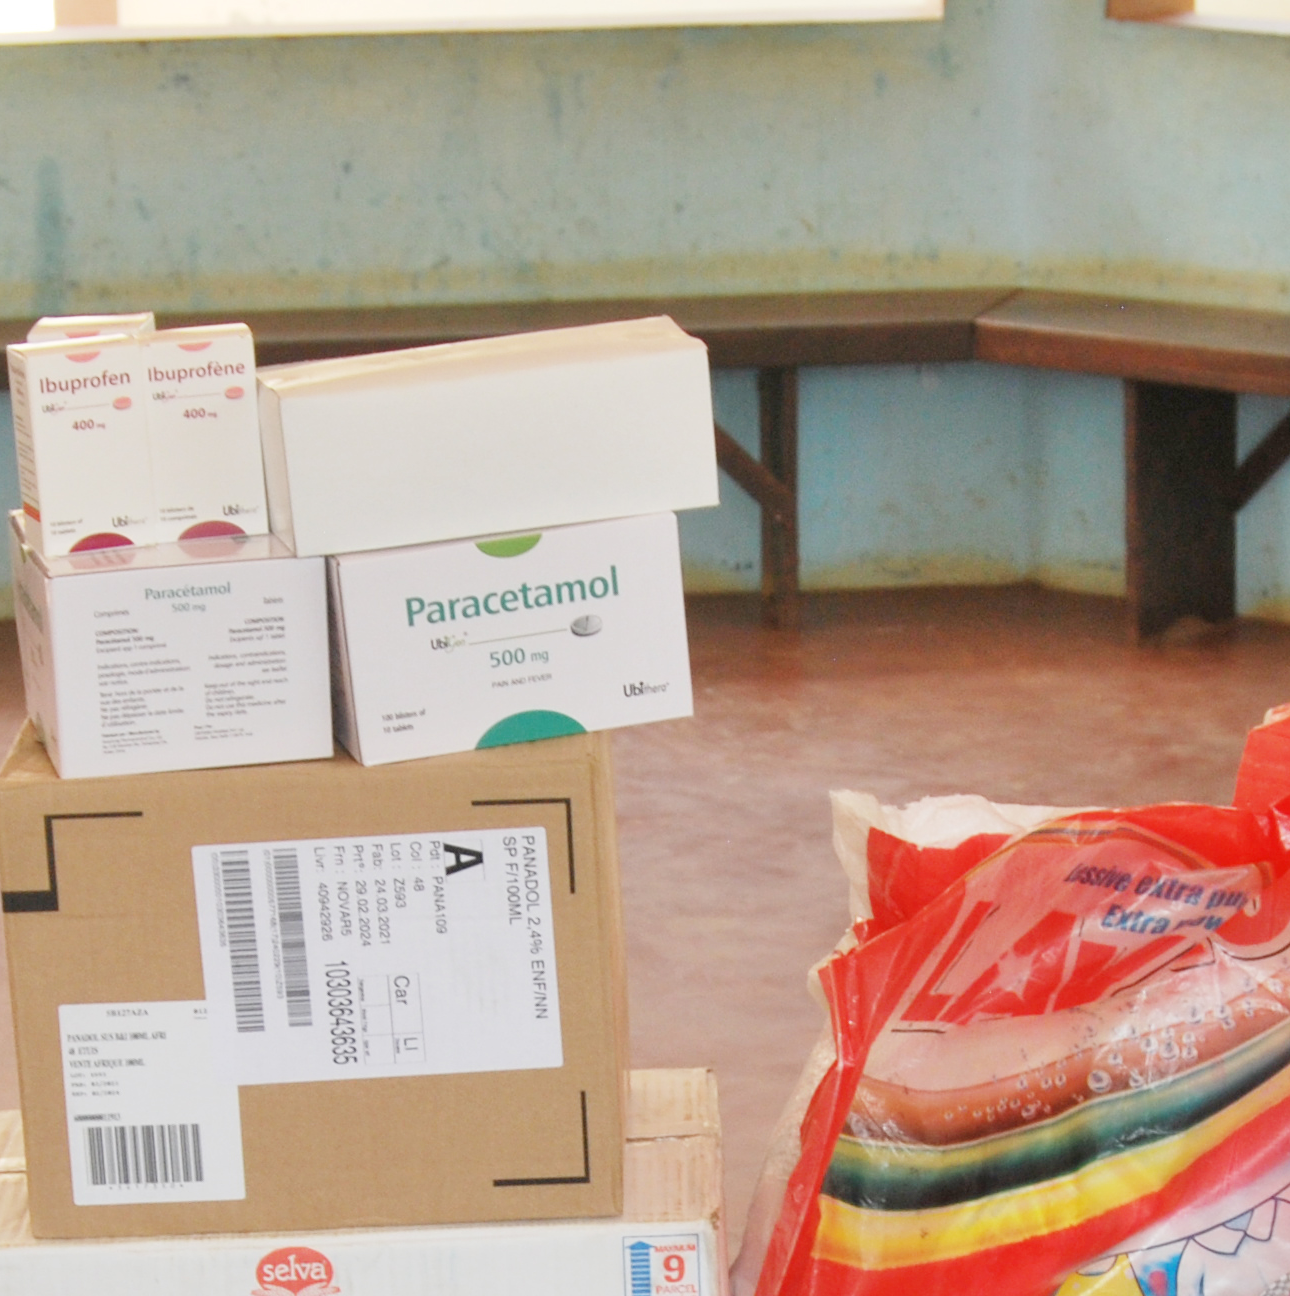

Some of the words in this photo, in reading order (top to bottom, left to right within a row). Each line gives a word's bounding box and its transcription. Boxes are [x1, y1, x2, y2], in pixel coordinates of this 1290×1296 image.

[40, 370, 130, 394] Ibuprofen
[148, 361, 245, 383] Ibuprofène
[72, 419, 94, 430] 400
[183, 408, 205, 419] 400
[144, 581, 232, 600] Paracétamol
[405, 565, 619, 627] Paracetamol
[171, 603, 189, 612] 500
[490, 648, 526, 668] 500
[530, 650, 549, 664] mg
[390, 843, 401, 861] Lot
[409, 841, 420, 861] Col
[429, 840, 440, 860] Pdt
[444, 842, 484, 875] A
[502, 836, 517, 856] SP
[413, 877, 424, 892] 48
[521, 835, 542, 910] PANADOL
[394, 878, 407, 908] Z593
[432, 876, 447, 934] PANA109
[505, 862, 523, 925] F/100ML
[1134, 876, 1204, 905] extra
[319, 882, 334, 941] 40942926
[356, 881, 372, 947] 29.02.2024
[375, 880, 391, 945] 24.03.2021
[1101, 904, 1171, 935] Extra
[526, 917, 544, 954] 2,4%
[394, 975, 410, 1005] Car
[530, 960, 549, 1019] ENF/NN
[325, 961, 357, 1065] 10303643635
[263, 1254, 327, 1282] selva
[663, 1254, 685, 1283] 9
